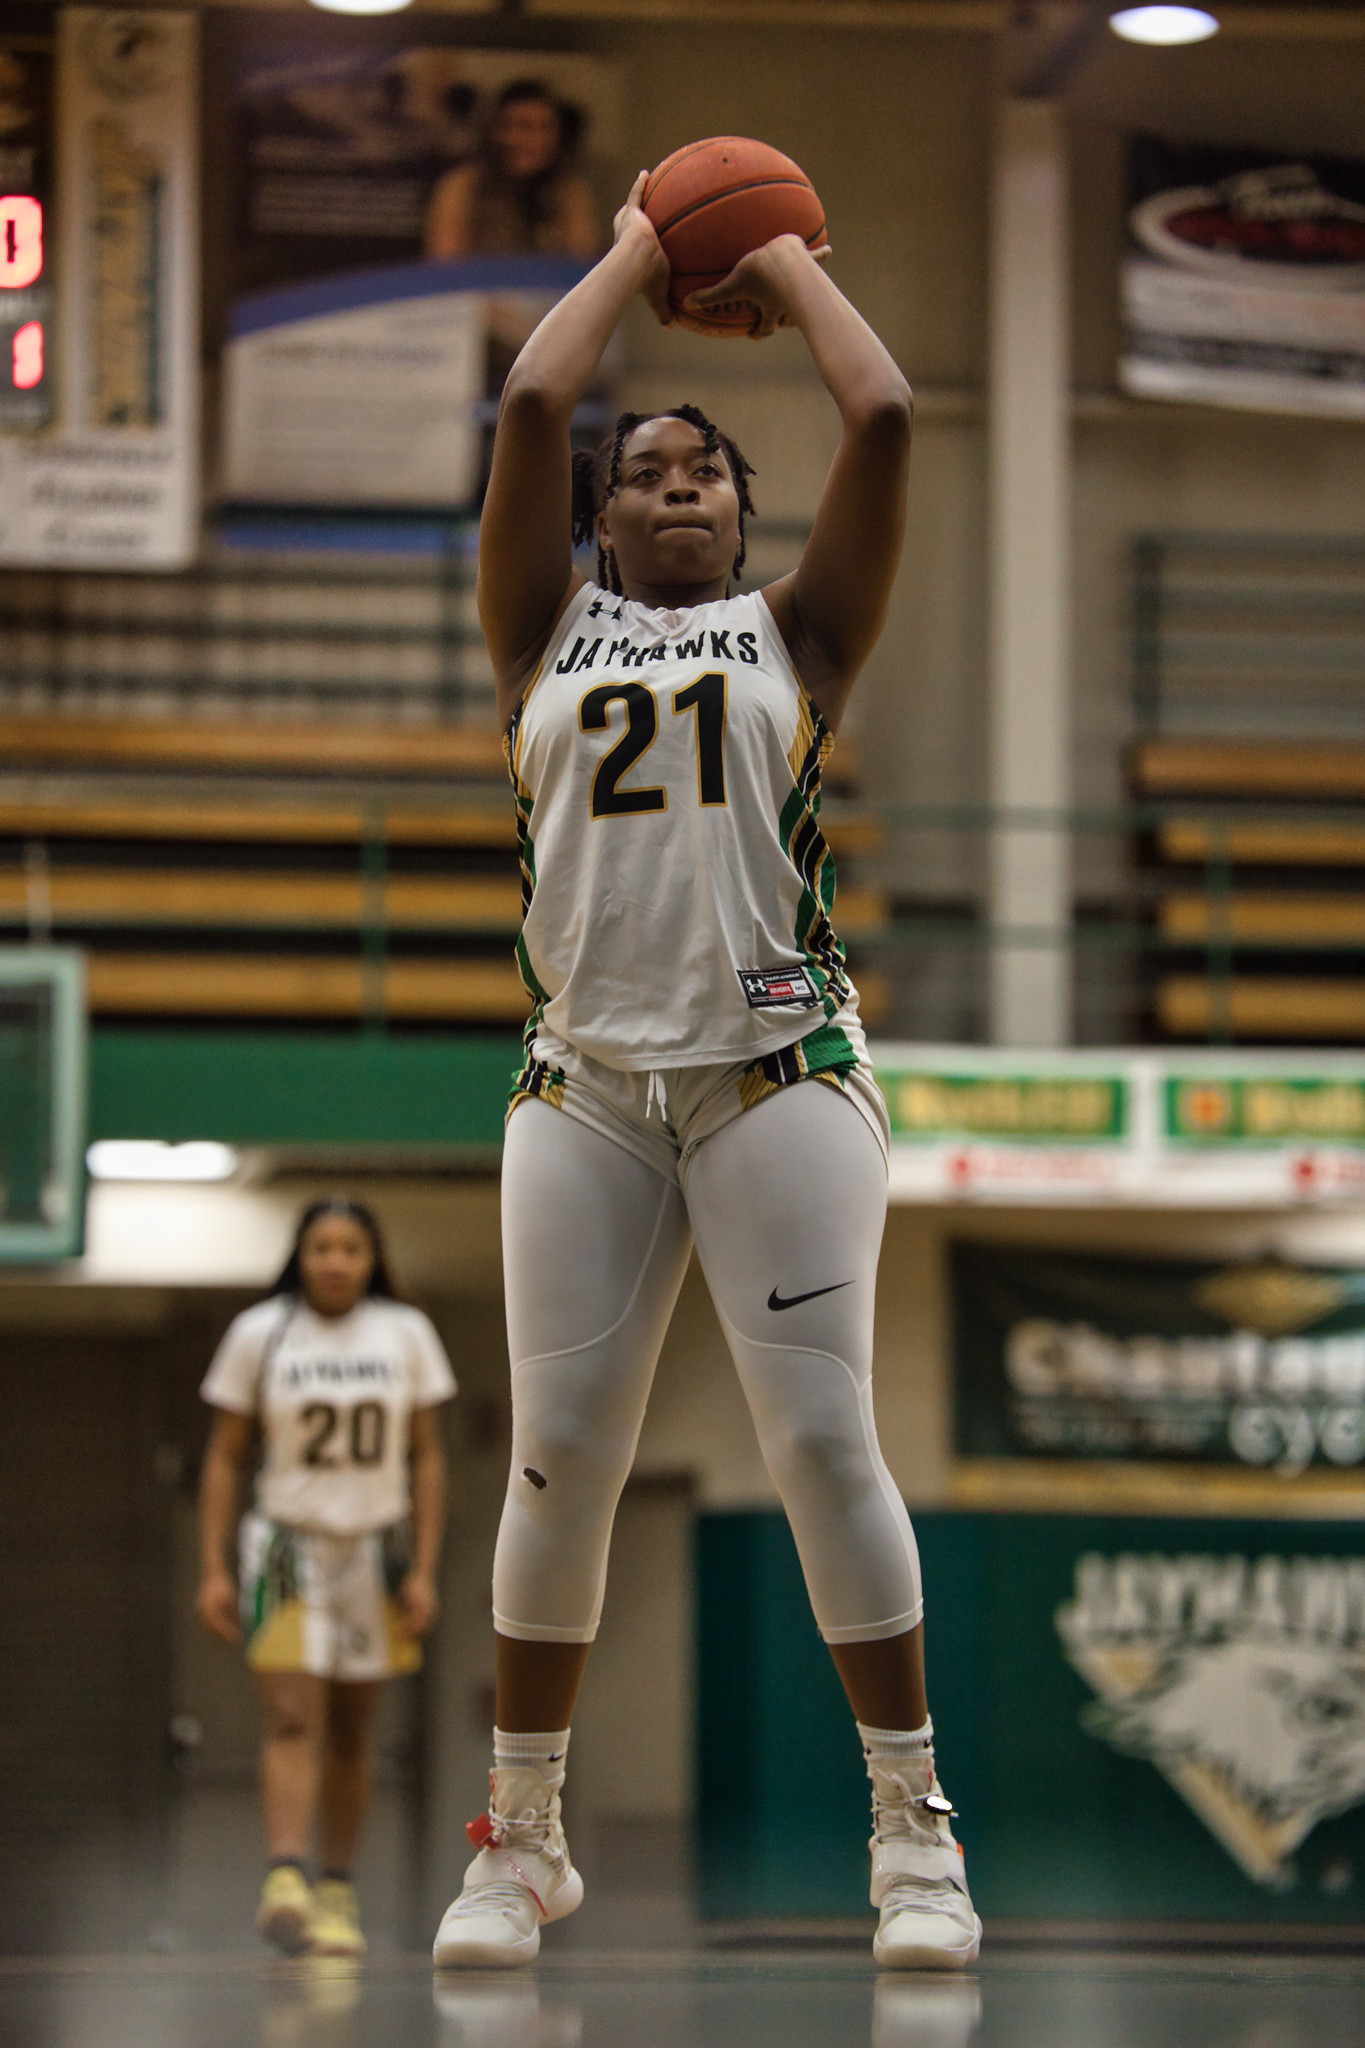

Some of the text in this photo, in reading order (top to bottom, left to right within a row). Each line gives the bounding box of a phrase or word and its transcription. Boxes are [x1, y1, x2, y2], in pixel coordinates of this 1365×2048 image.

[556, 630, 759, 675] JAYHAWKS
[577, 671, 728, 821] 21
[301, 1401, 385, 1469] 20
